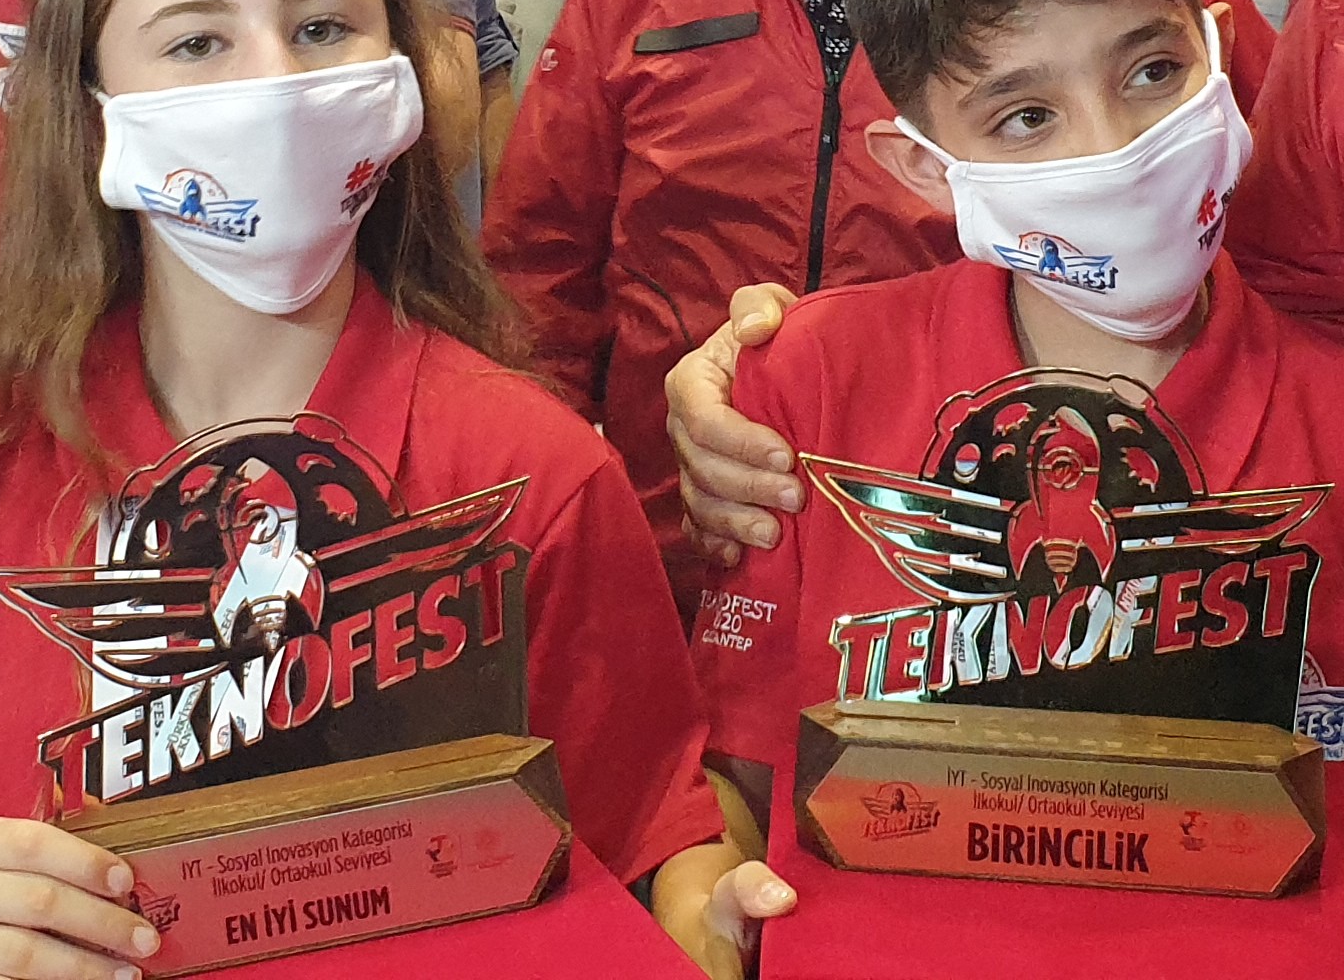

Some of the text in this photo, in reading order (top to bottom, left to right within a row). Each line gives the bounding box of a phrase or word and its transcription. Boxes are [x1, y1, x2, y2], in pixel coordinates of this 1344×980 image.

[830, 552, 1308, 703] TEKNOFEST
[38, 550, 519, 820] TEKNOFEST
[981, 771, 1023, 793] Sosyal
[1099, 779, 1169, 802] Kategorisi
[1028, 796, 1086, 817] Ortaokul
[1090, 799, 1145, 822] Seviyesi
[216, 848, 263, 875] Sosyal
[341, 820, 413, 849] Kategorisi
[271, 857, 332, 886] Ortaokul
[334, 846, 392, 875] Seviyesi
[225, 911, 258, 945] EN
[263, 899, 297, 937] İYİ
[303, 886, 391, 931] SUNUM
